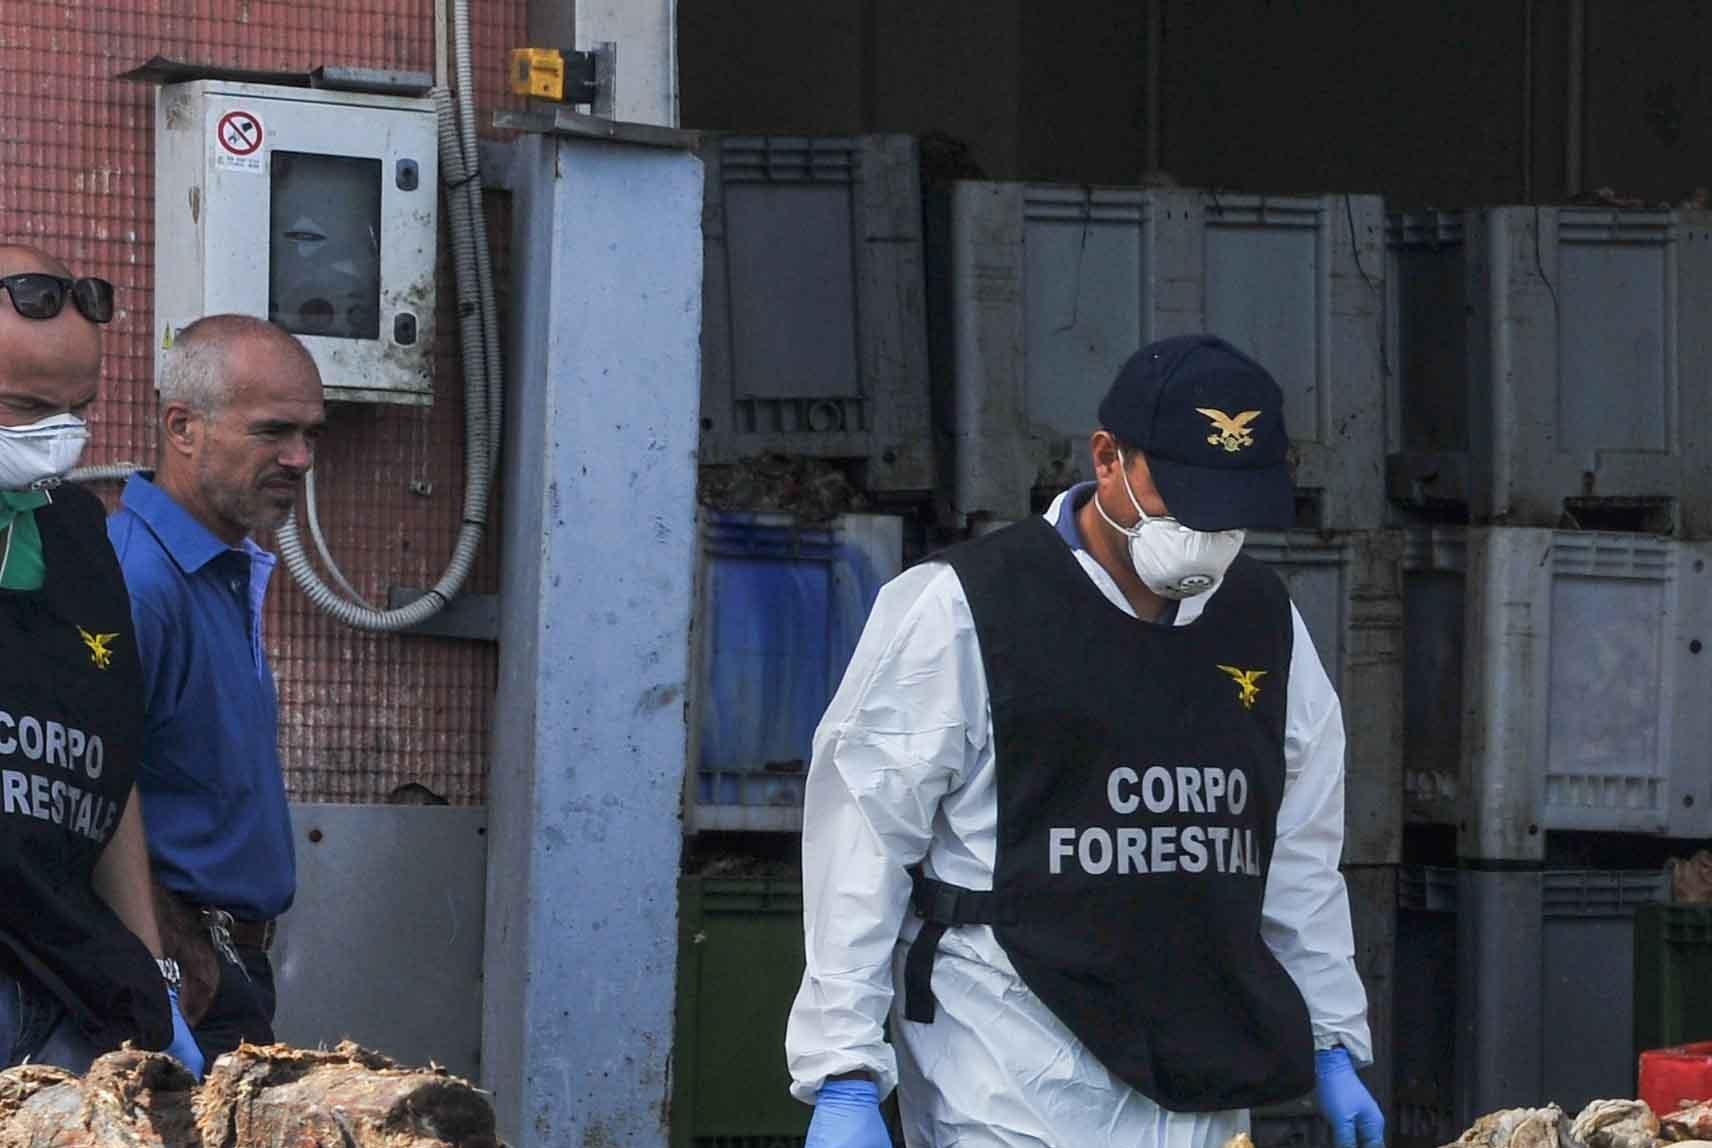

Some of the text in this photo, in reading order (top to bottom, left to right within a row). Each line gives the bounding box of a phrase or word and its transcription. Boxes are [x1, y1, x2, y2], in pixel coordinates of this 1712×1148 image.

[0, 710, 104, 780] CORPO
[1, 768, 118, 843] RESTALE
[1106, 766, 1248, 816] CORPO
[1048, 825, 1261, 877] FORESTAL
